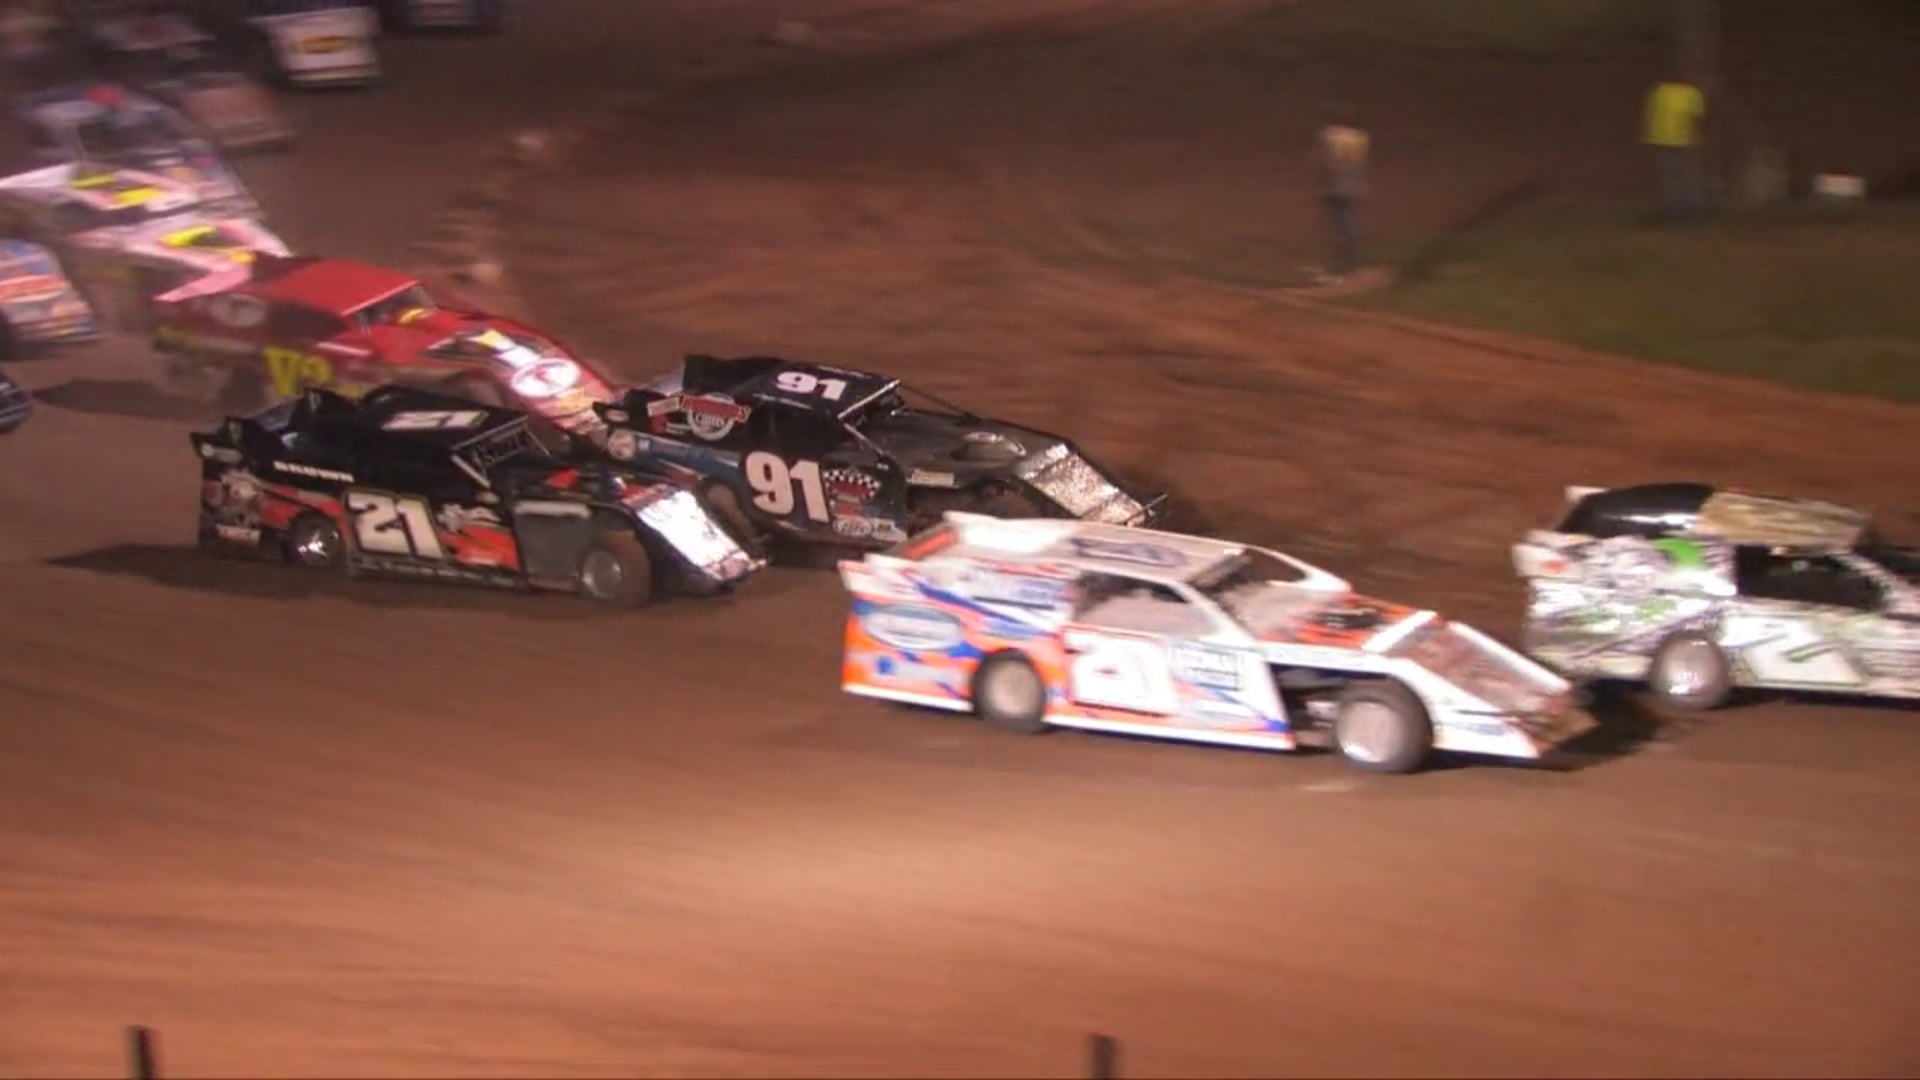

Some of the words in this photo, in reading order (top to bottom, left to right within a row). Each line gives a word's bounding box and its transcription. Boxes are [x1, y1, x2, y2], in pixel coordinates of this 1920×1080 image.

[776, 371, 847, 400] 91
[746, 450, 830, 523] 91
[348, 491, 443, 559] 21
